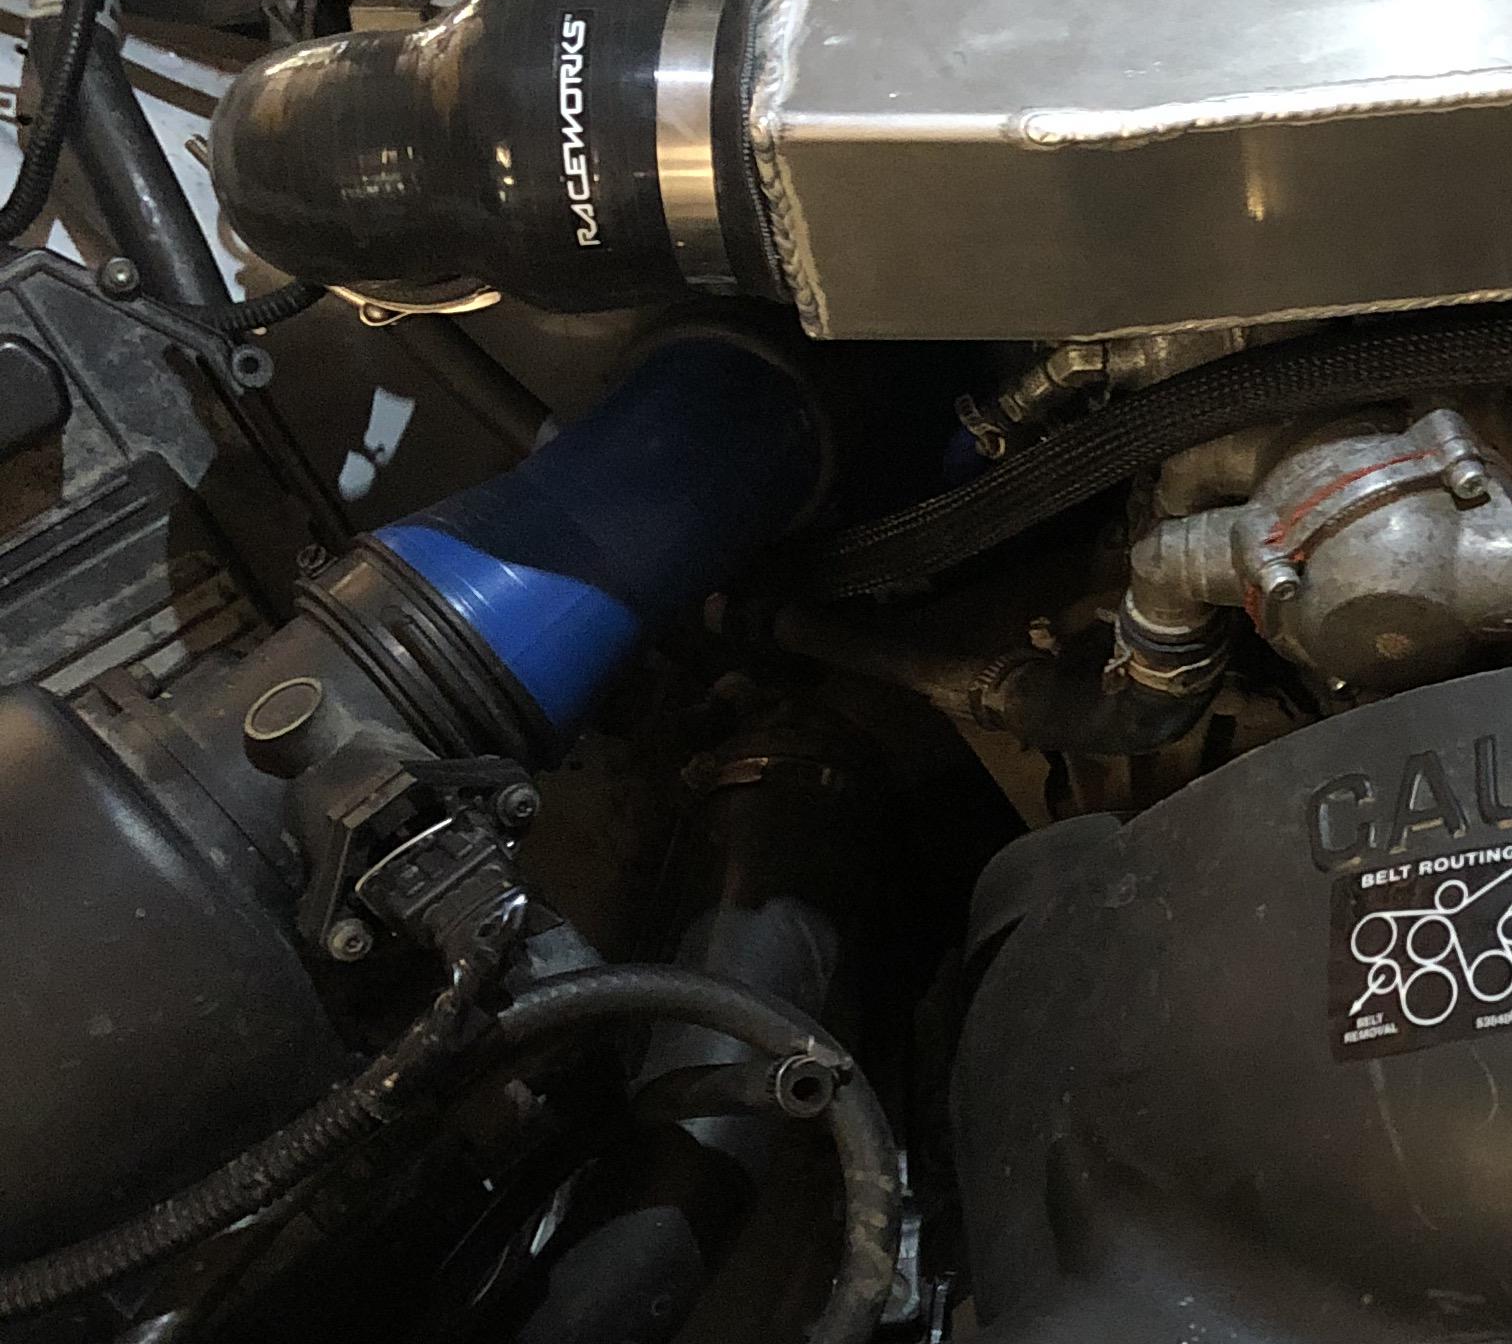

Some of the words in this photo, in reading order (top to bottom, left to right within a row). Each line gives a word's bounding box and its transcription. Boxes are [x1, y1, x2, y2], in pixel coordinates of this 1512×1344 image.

[559, 16, 601, 246] RACEWORKS
[1361, 864, 1411, 888] BELT
[1356, 1012, 1384, 1029] BELT
[1344, 1023, 1398, 1044] REMOVAL
